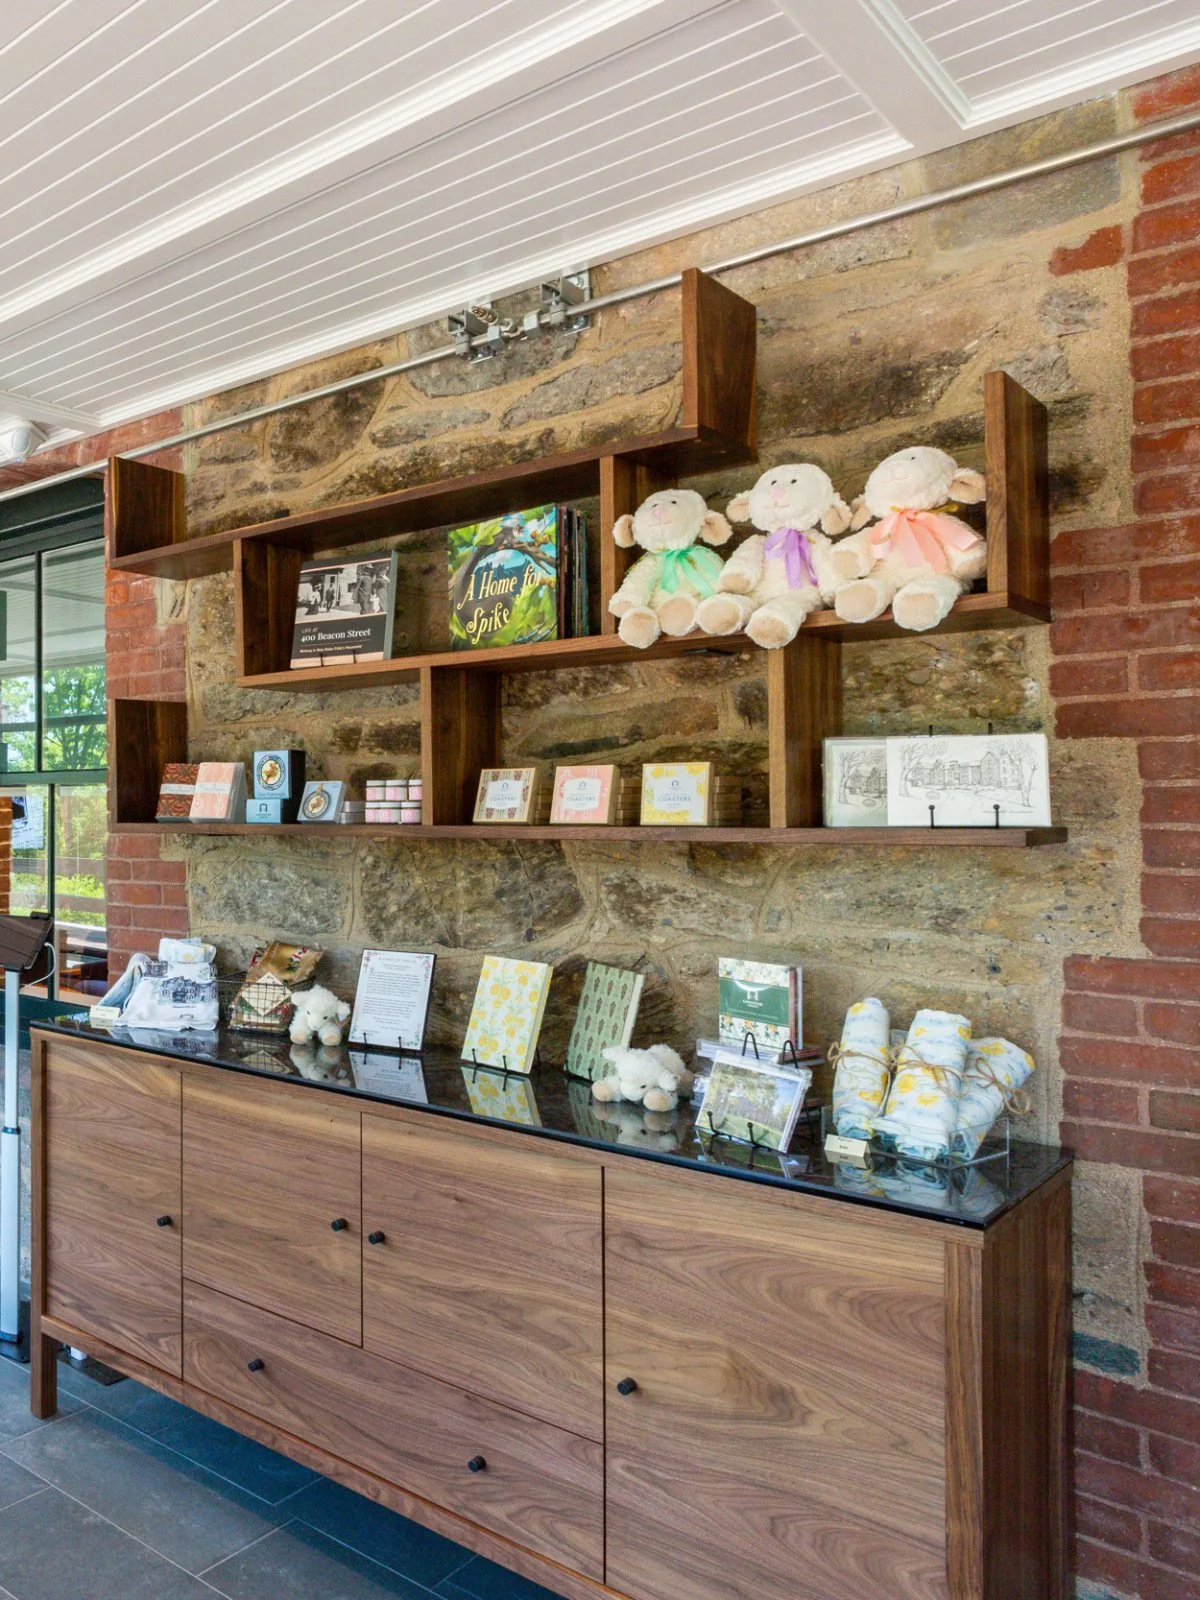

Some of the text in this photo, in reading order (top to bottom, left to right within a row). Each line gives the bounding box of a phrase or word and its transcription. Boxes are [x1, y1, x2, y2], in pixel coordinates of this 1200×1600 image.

[457, 565, 541, 610] A Home for
[300, 628, 371, 643] 400 Beacon Street
[466, 602, 511, 645] Spike
